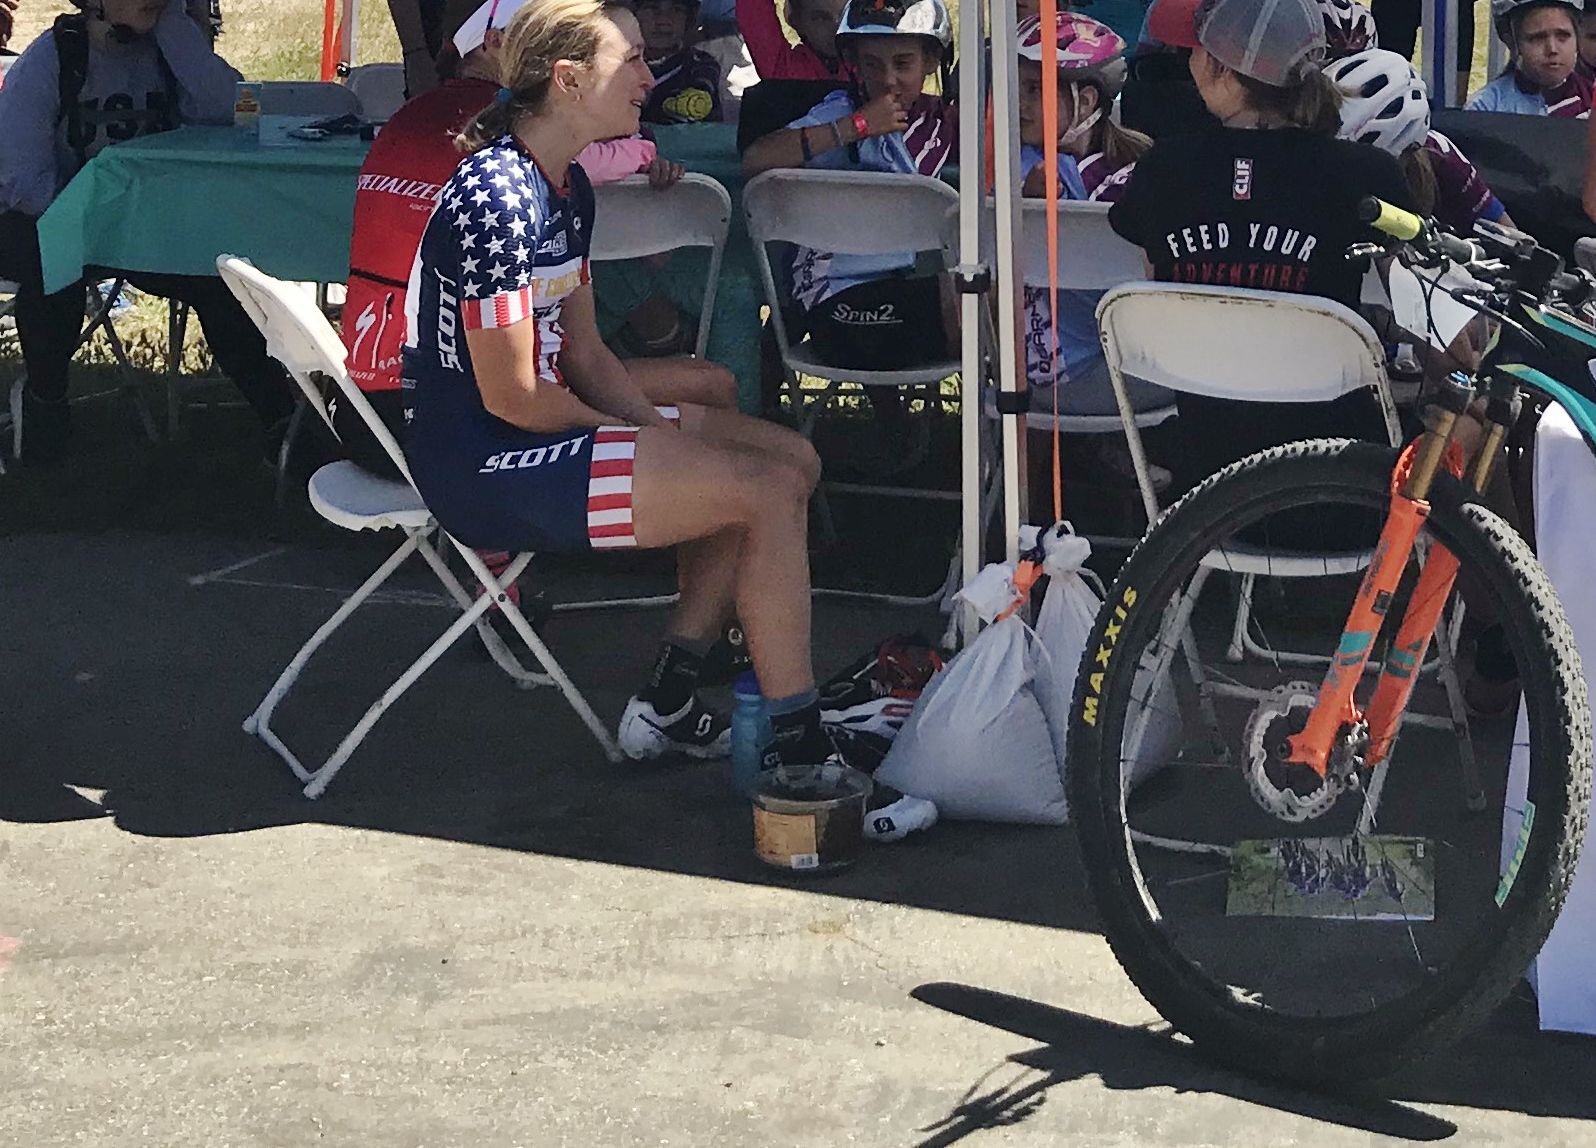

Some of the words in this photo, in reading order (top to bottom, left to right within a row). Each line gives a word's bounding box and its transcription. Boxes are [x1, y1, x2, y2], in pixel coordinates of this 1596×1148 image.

[1235, 159, 1252, 195] CLIF
[1166, 222, 1230, 258] FEED
[1248, 222, 1318, 262] YOUR
[437, 267, 465, 373] SCOTT
[479, 434, 589, 474] SCOTT
[1083, 585, 1139, 727] MAXXIS
